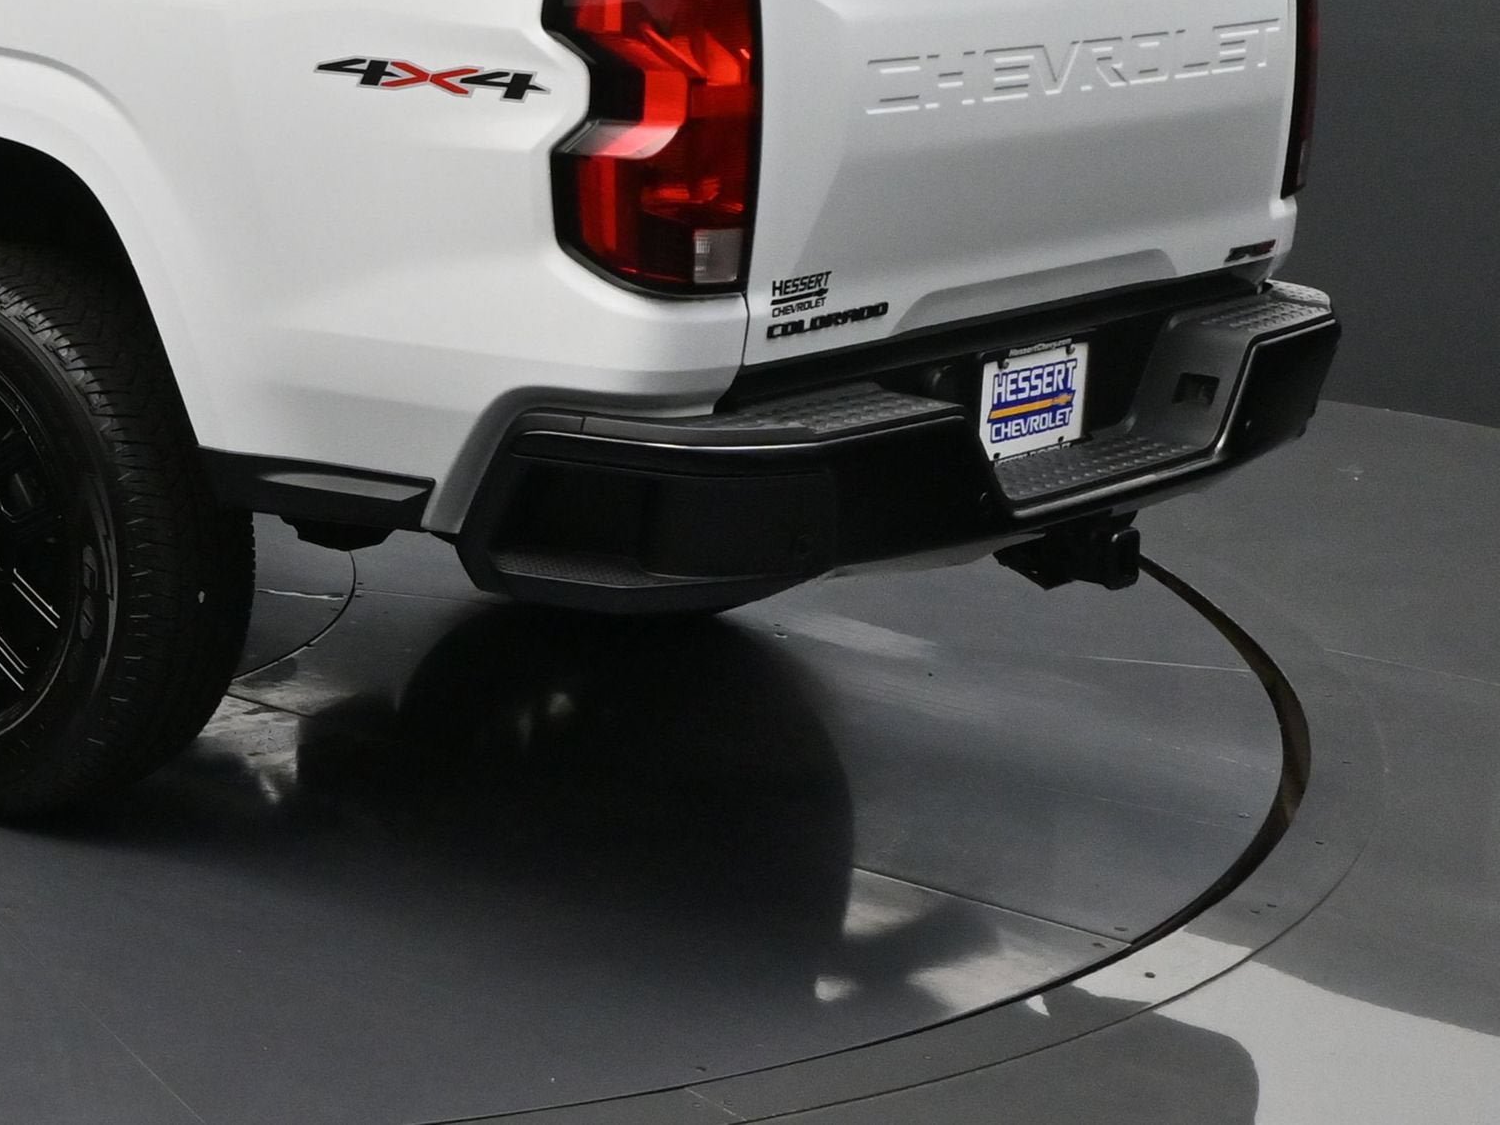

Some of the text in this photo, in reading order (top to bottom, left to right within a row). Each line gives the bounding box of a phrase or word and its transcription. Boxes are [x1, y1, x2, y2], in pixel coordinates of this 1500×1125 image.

[866, 18, 1280, 114] CHEVROLET
[771, 270, 833, 297] HESSERT
[765, 301, 889, 339] COLORADO
[771, 296, 827, 318] CHEVROLET
[992, 358, 1078, 405] HESSERT
[990, 406, 1073, 443] CHEVROLET
